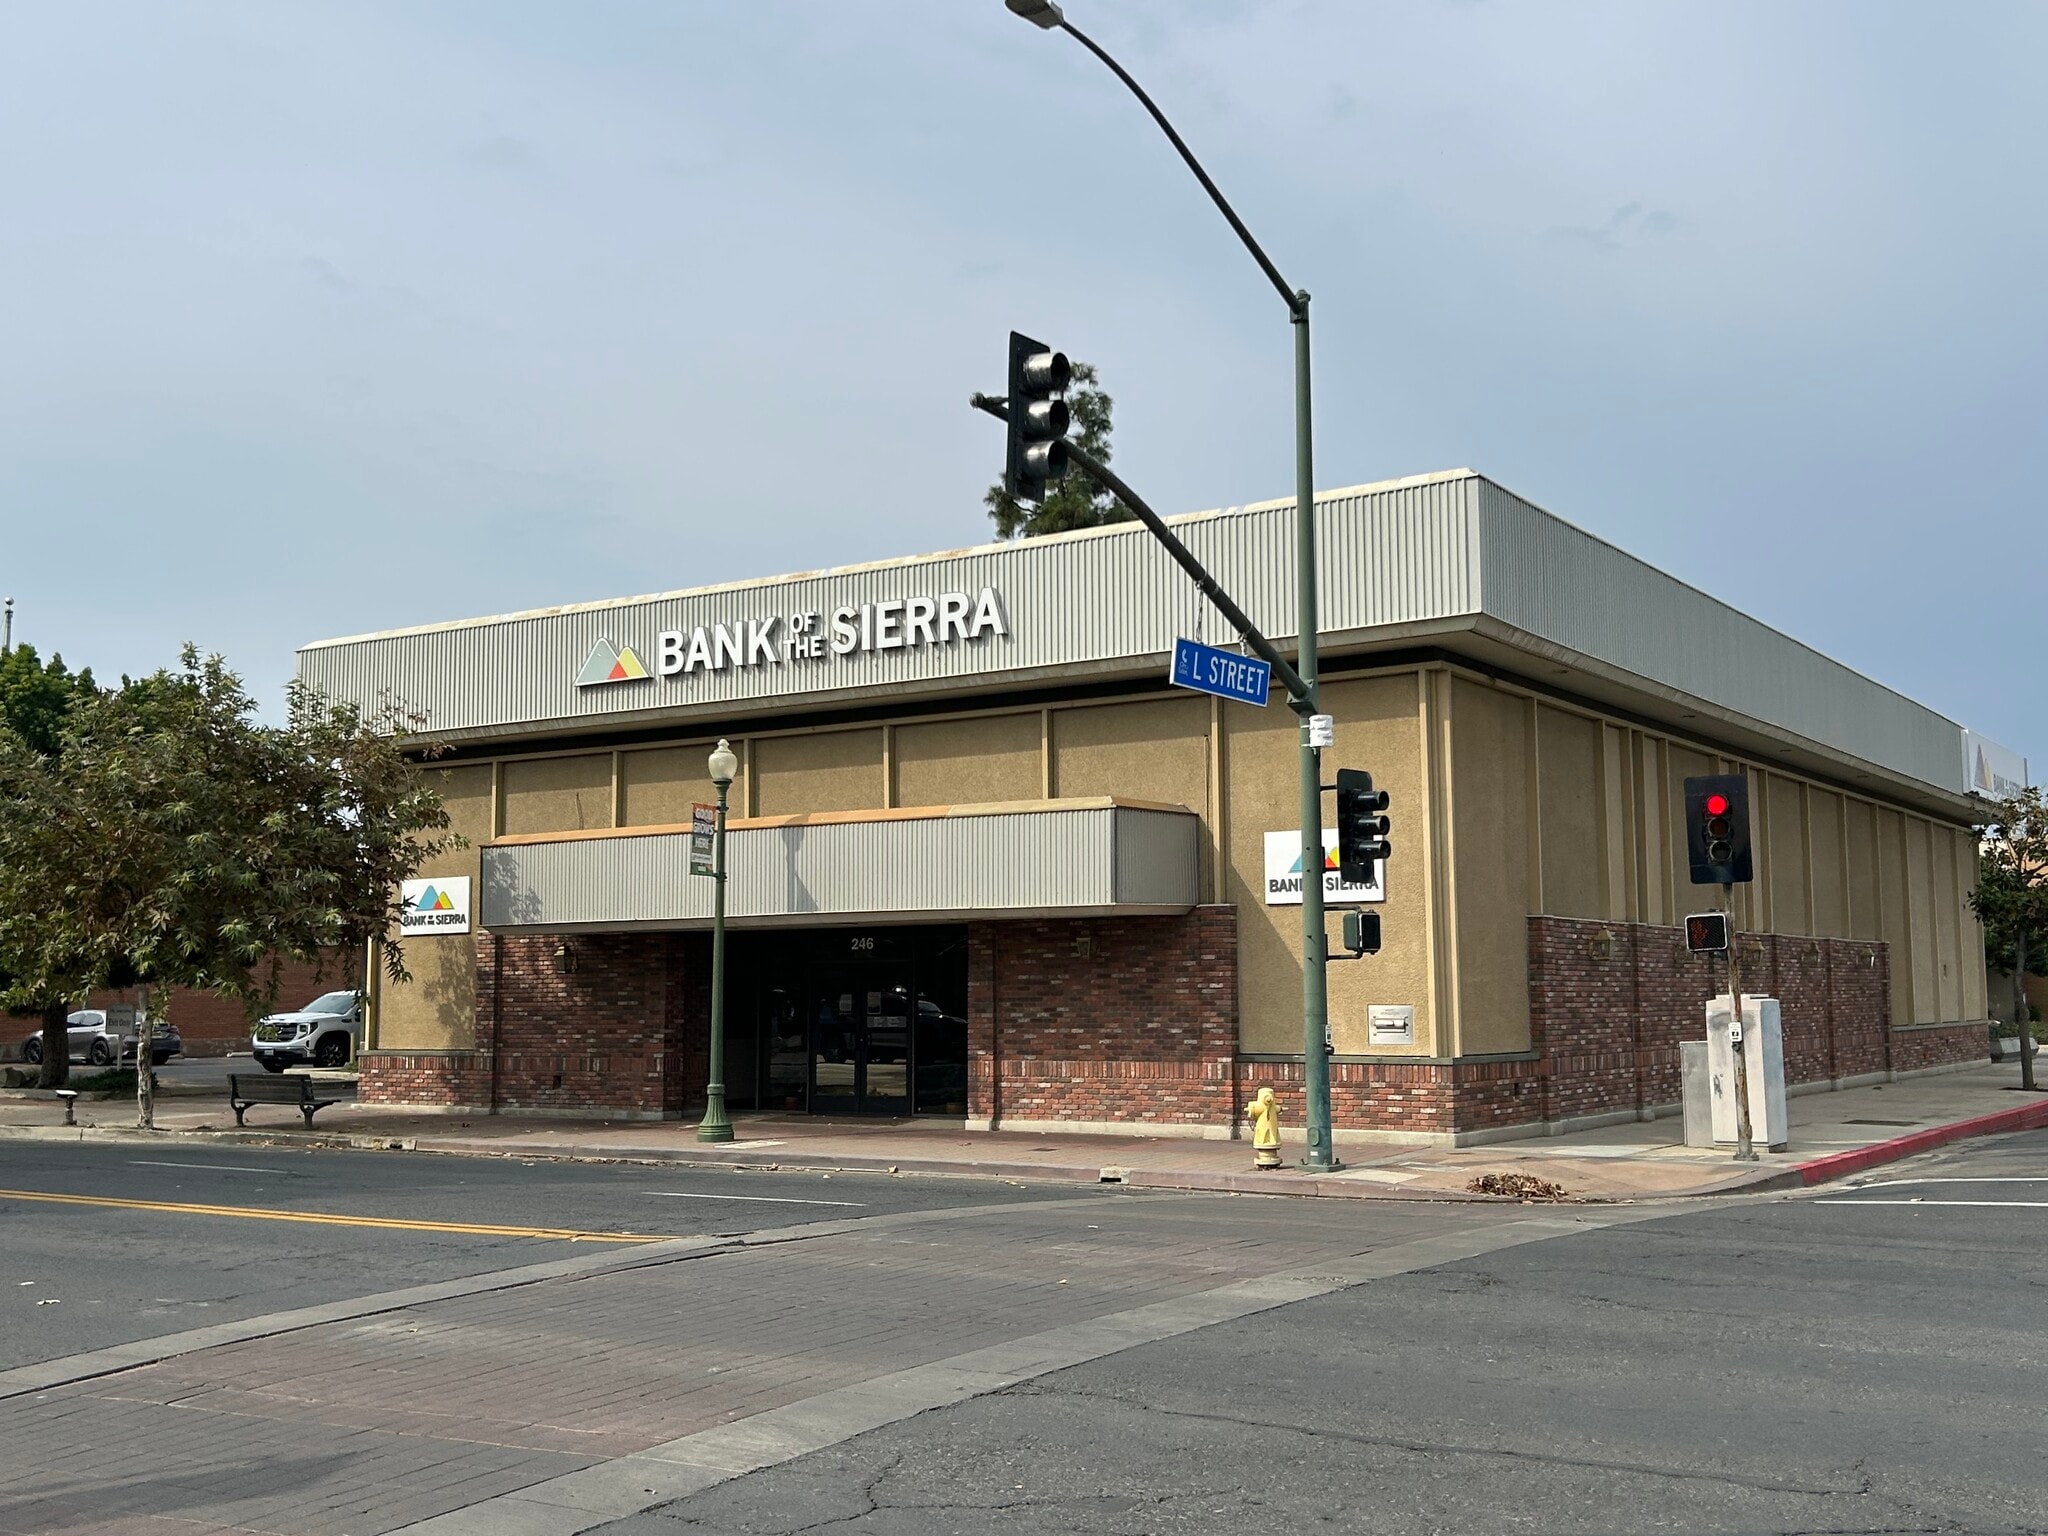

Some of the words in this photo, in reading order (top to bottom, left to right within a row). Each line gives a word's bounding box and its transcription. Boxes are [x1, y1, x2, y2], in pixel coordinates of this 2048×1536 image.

[790, 611, 817, 634] OF
[830, 586, 1007, 654] SIERRA
[658, 616, 781, 676] BANK
[783, 635, 824, 661] THE
[1193, 651, 1202, 681] L
[1209, 656, 1265, 696] STREET
[435, 913, 467, 926] SIERRA
[851, 937, 874, 950] 246
